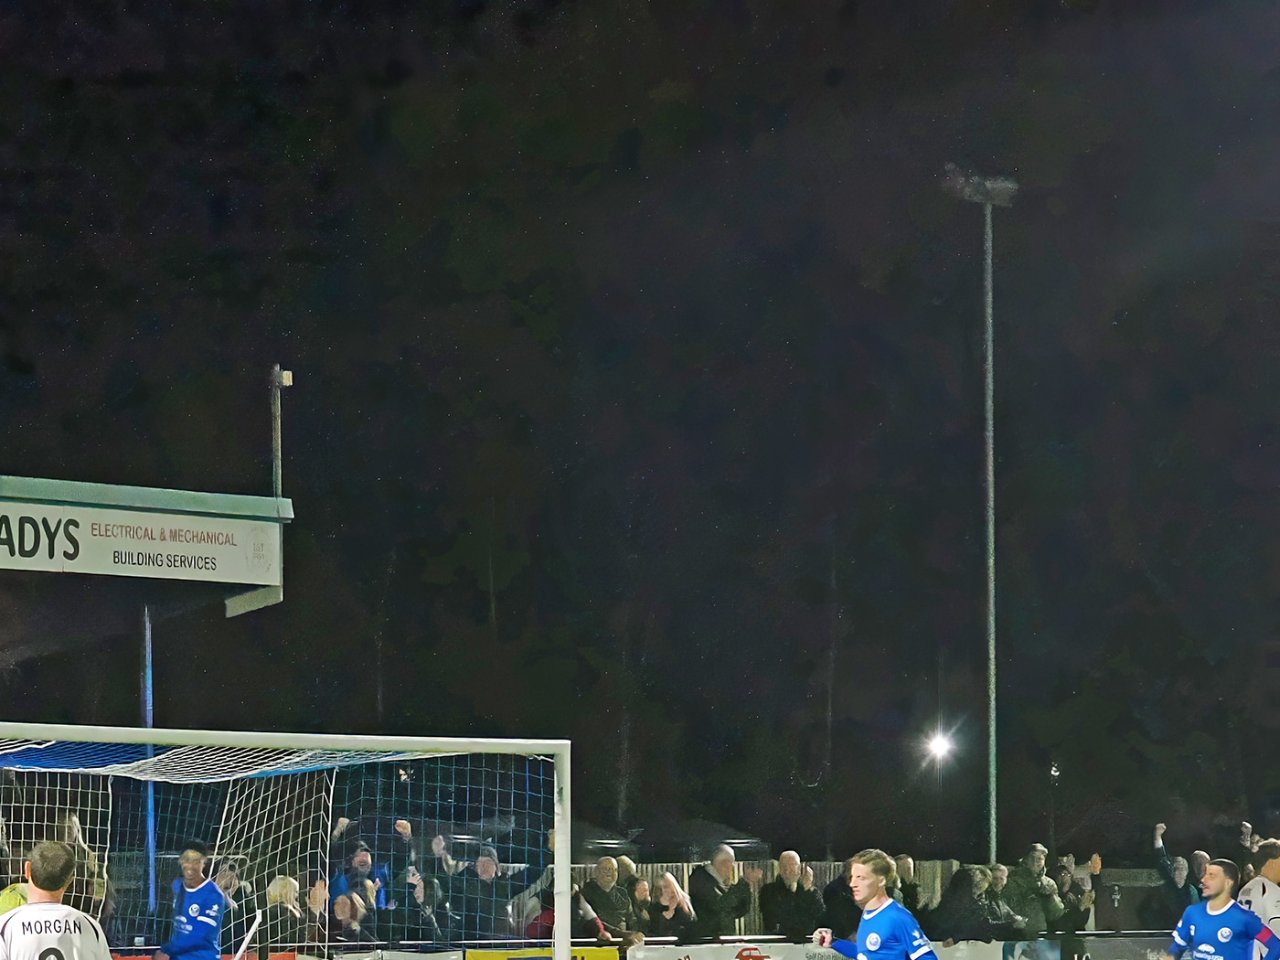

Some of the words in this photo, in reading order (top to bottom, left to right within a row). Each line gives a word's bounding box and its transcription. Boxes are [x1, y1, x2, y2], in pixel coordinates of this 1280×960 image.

[91, 523, 156, 542] ELECTRICAL
[159, 528, 166, 541] &
[169, 528, 237, 547] MECHANICAL
[113, 550, 163, 567] BUILDING
[166, 554, 217, 571] SERVICES
[22, 919, 82, 935] MORGAN
